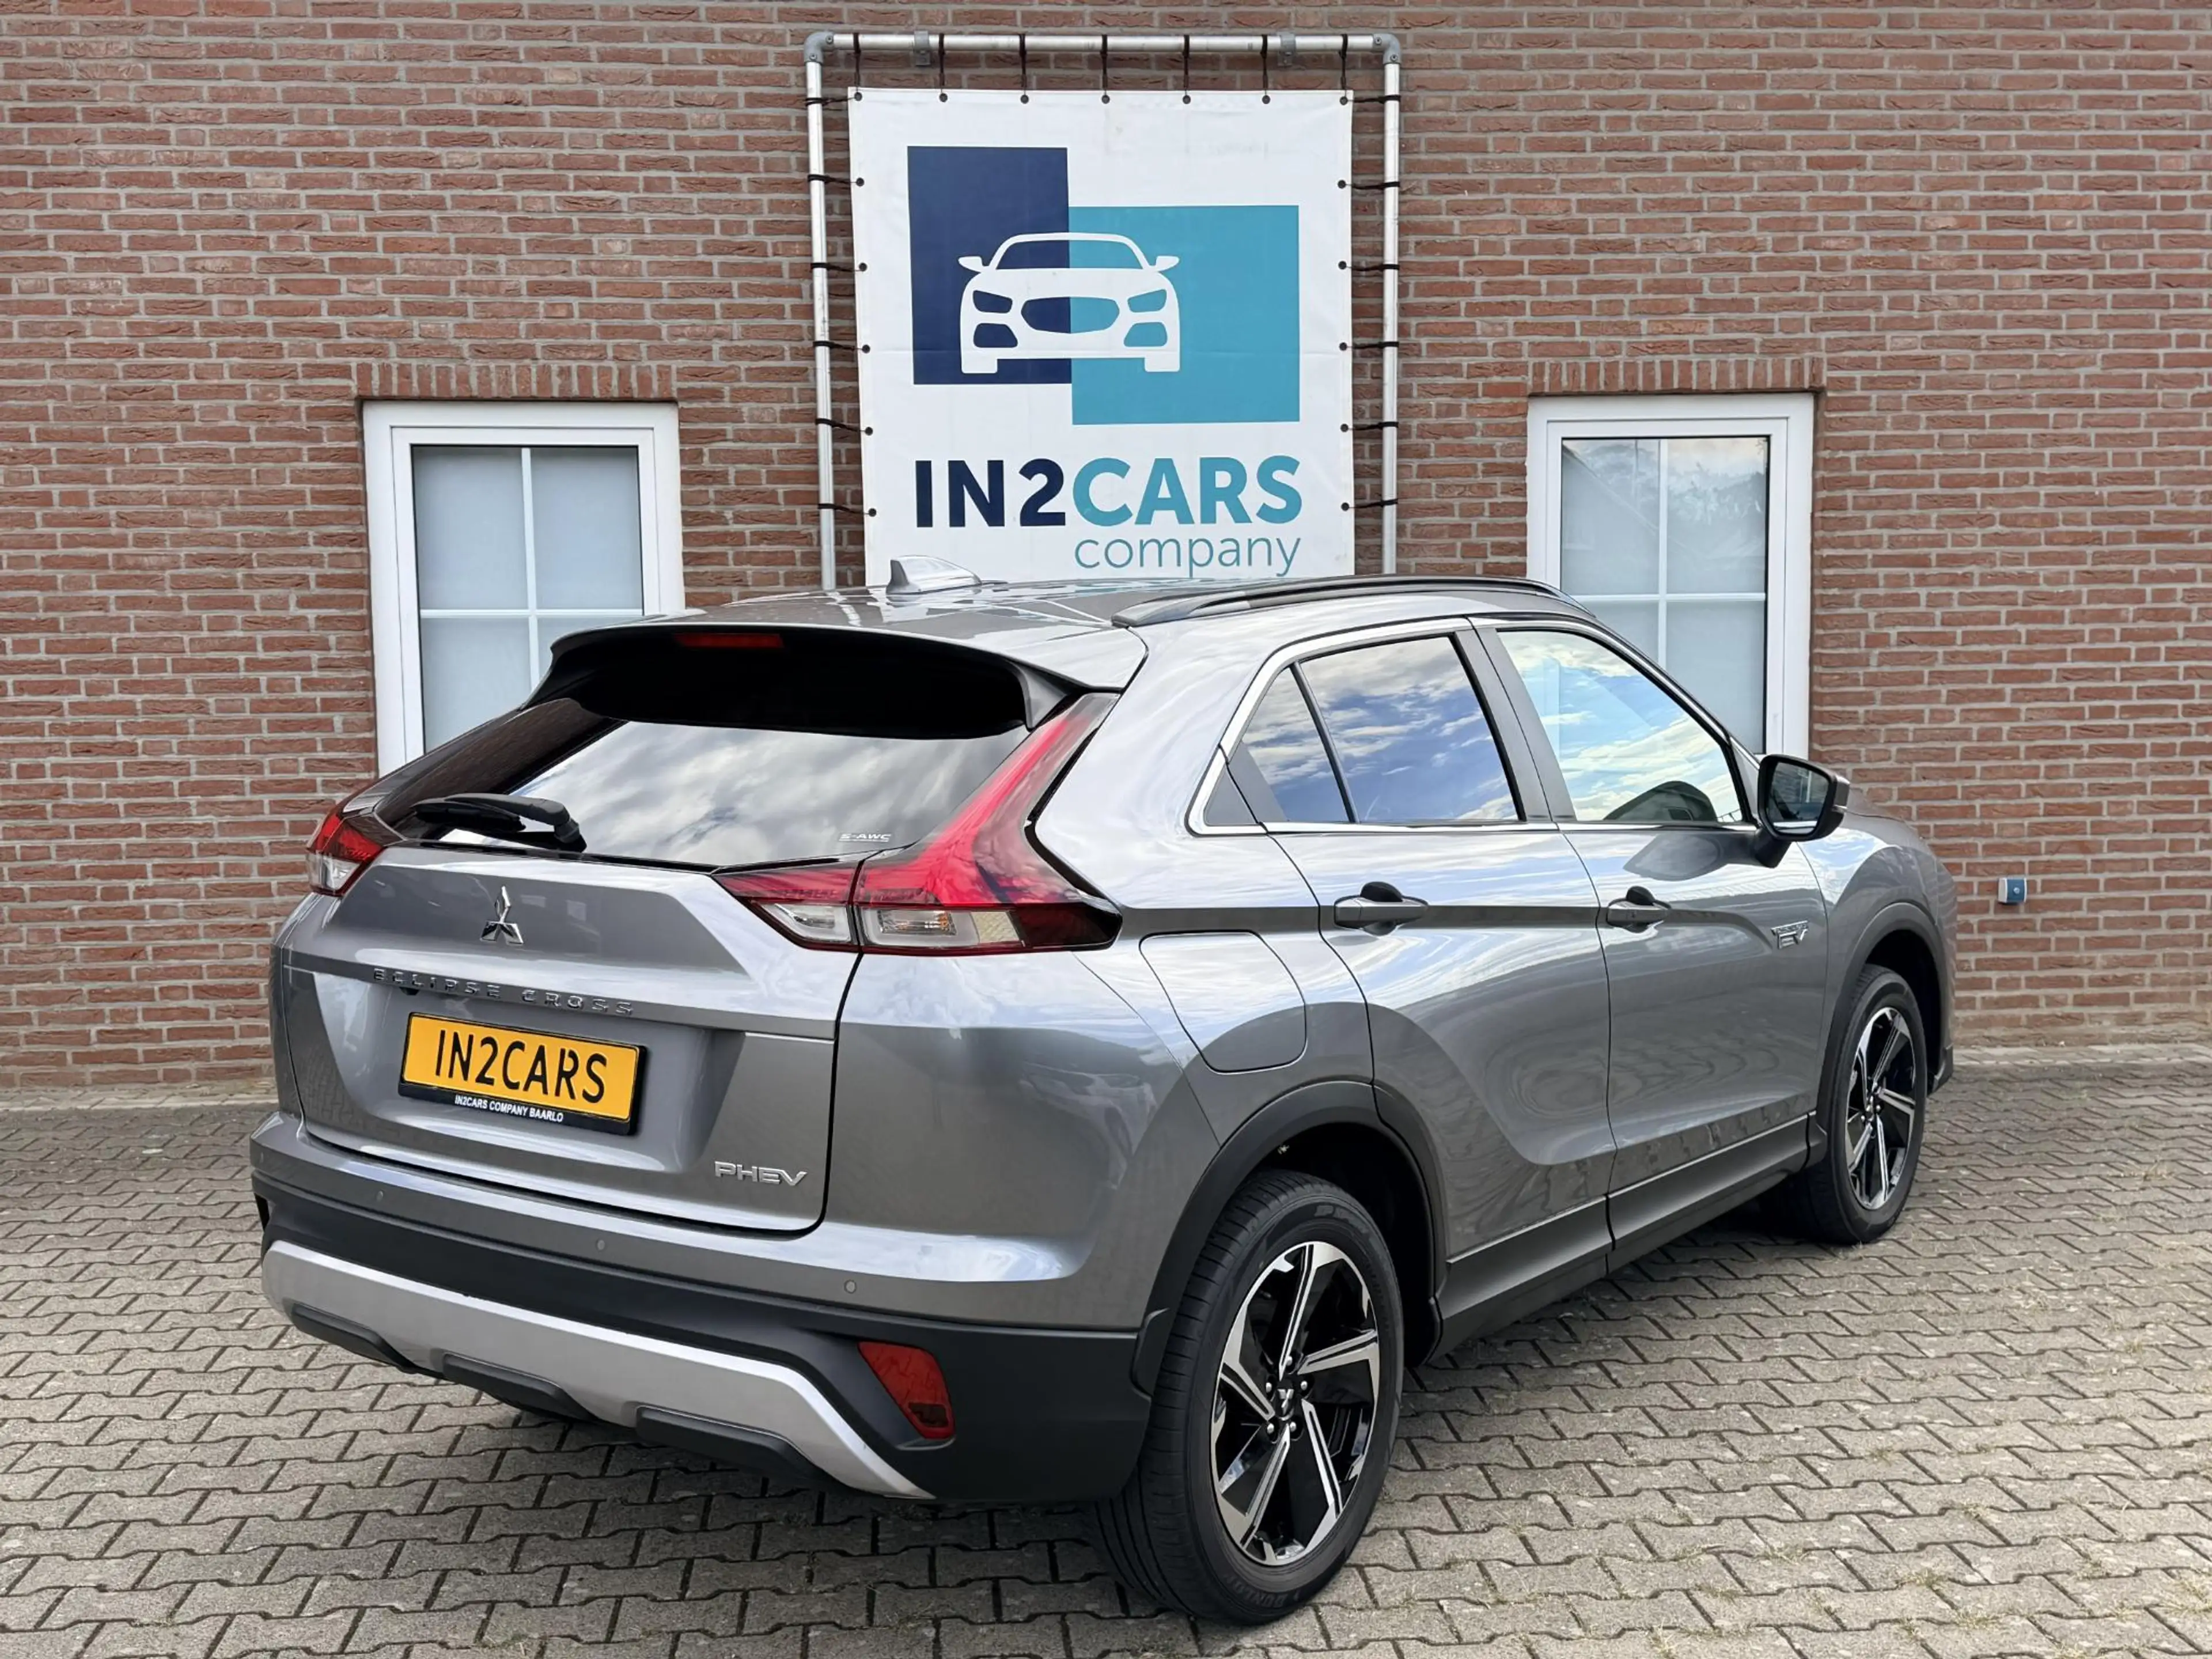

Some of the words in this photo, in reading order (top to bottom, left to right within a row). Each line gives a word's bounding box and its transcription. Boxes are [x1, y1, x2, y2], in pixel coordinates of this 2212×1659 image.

[915, 455, 1302, 528] IN2CARS
[1074, 537, 1301, 578] company
[373, 968, 501, 998] ECLIPSE
[521, 988, 633, 1016] CROSS
[435, 1029, 608, 1104] IN2CARS
[454, 1094, 487, 1109] IN2CARS
[489, 1101, 528, 1116] COMPANY
[529, 1107, 564, 1122] BAARLO
[715, 1161, 808, 1186] PHEV
